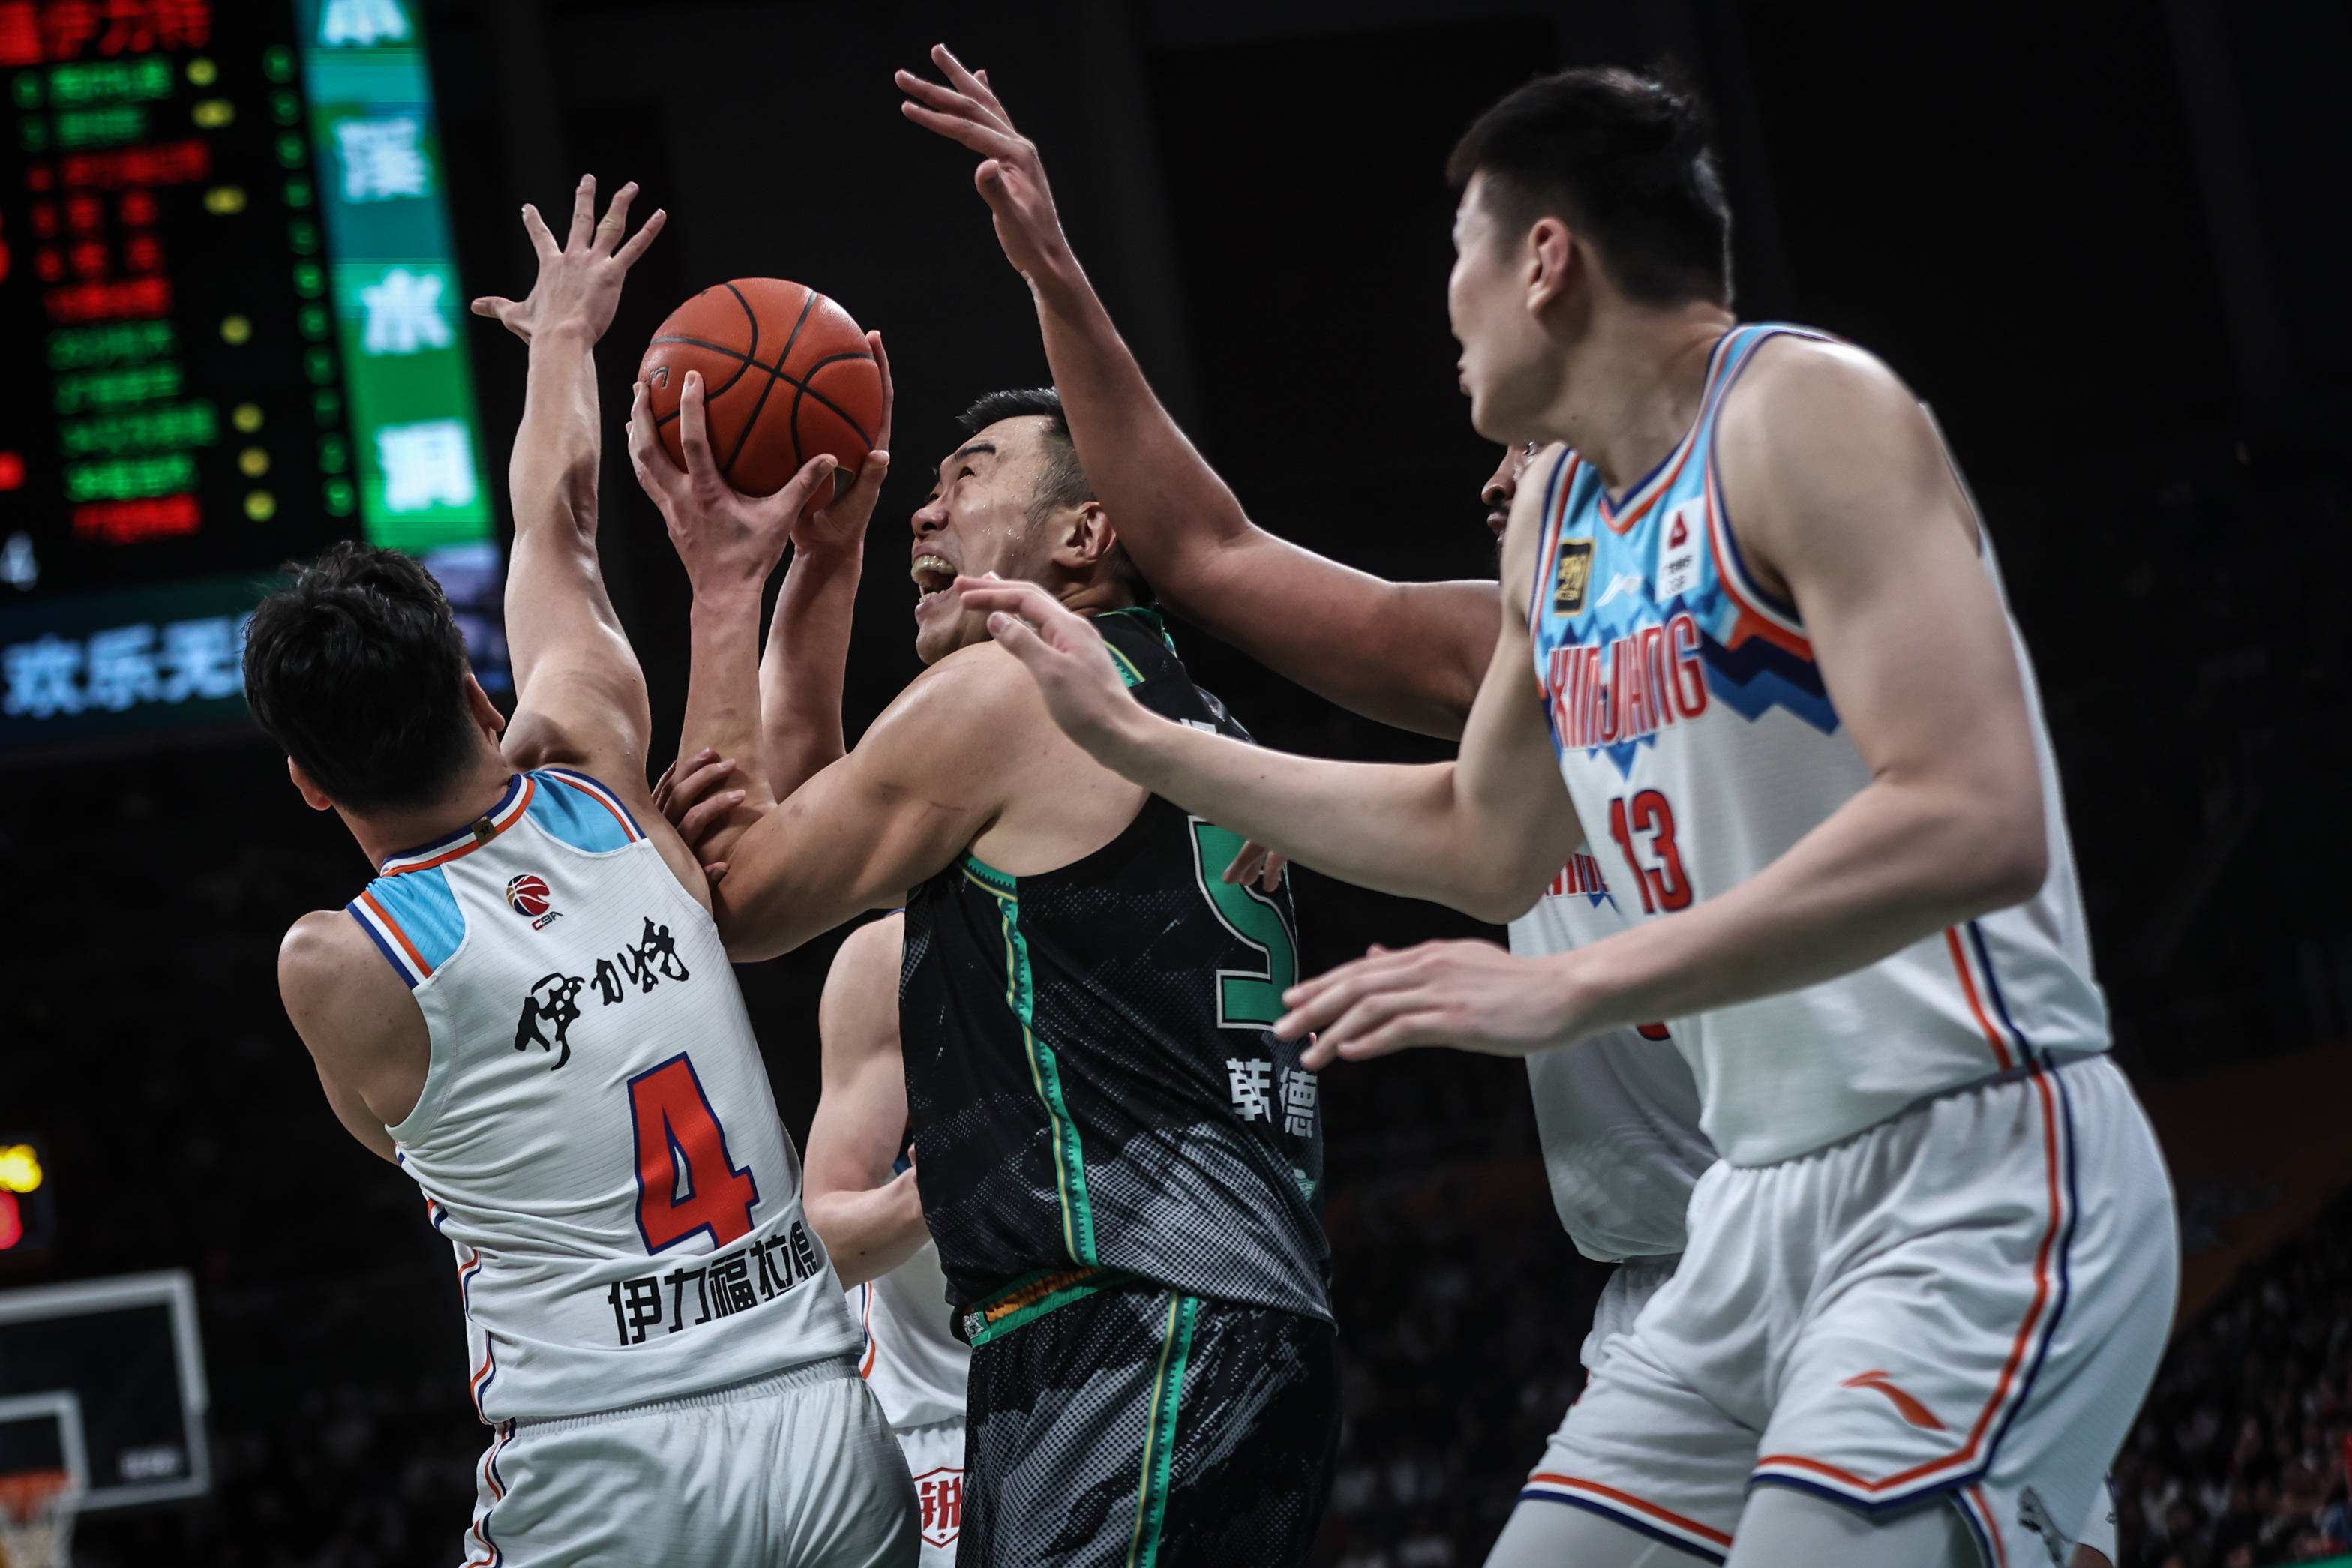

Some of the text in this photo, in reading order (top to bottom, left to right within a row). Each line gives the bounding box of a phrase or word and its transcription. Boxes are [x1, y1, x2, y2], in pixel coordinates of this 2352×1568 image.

[1609, 788, 1695, 914] 13
[531, 910, 564, 931] CBA
[626, 1050, 760, 1256] 4
